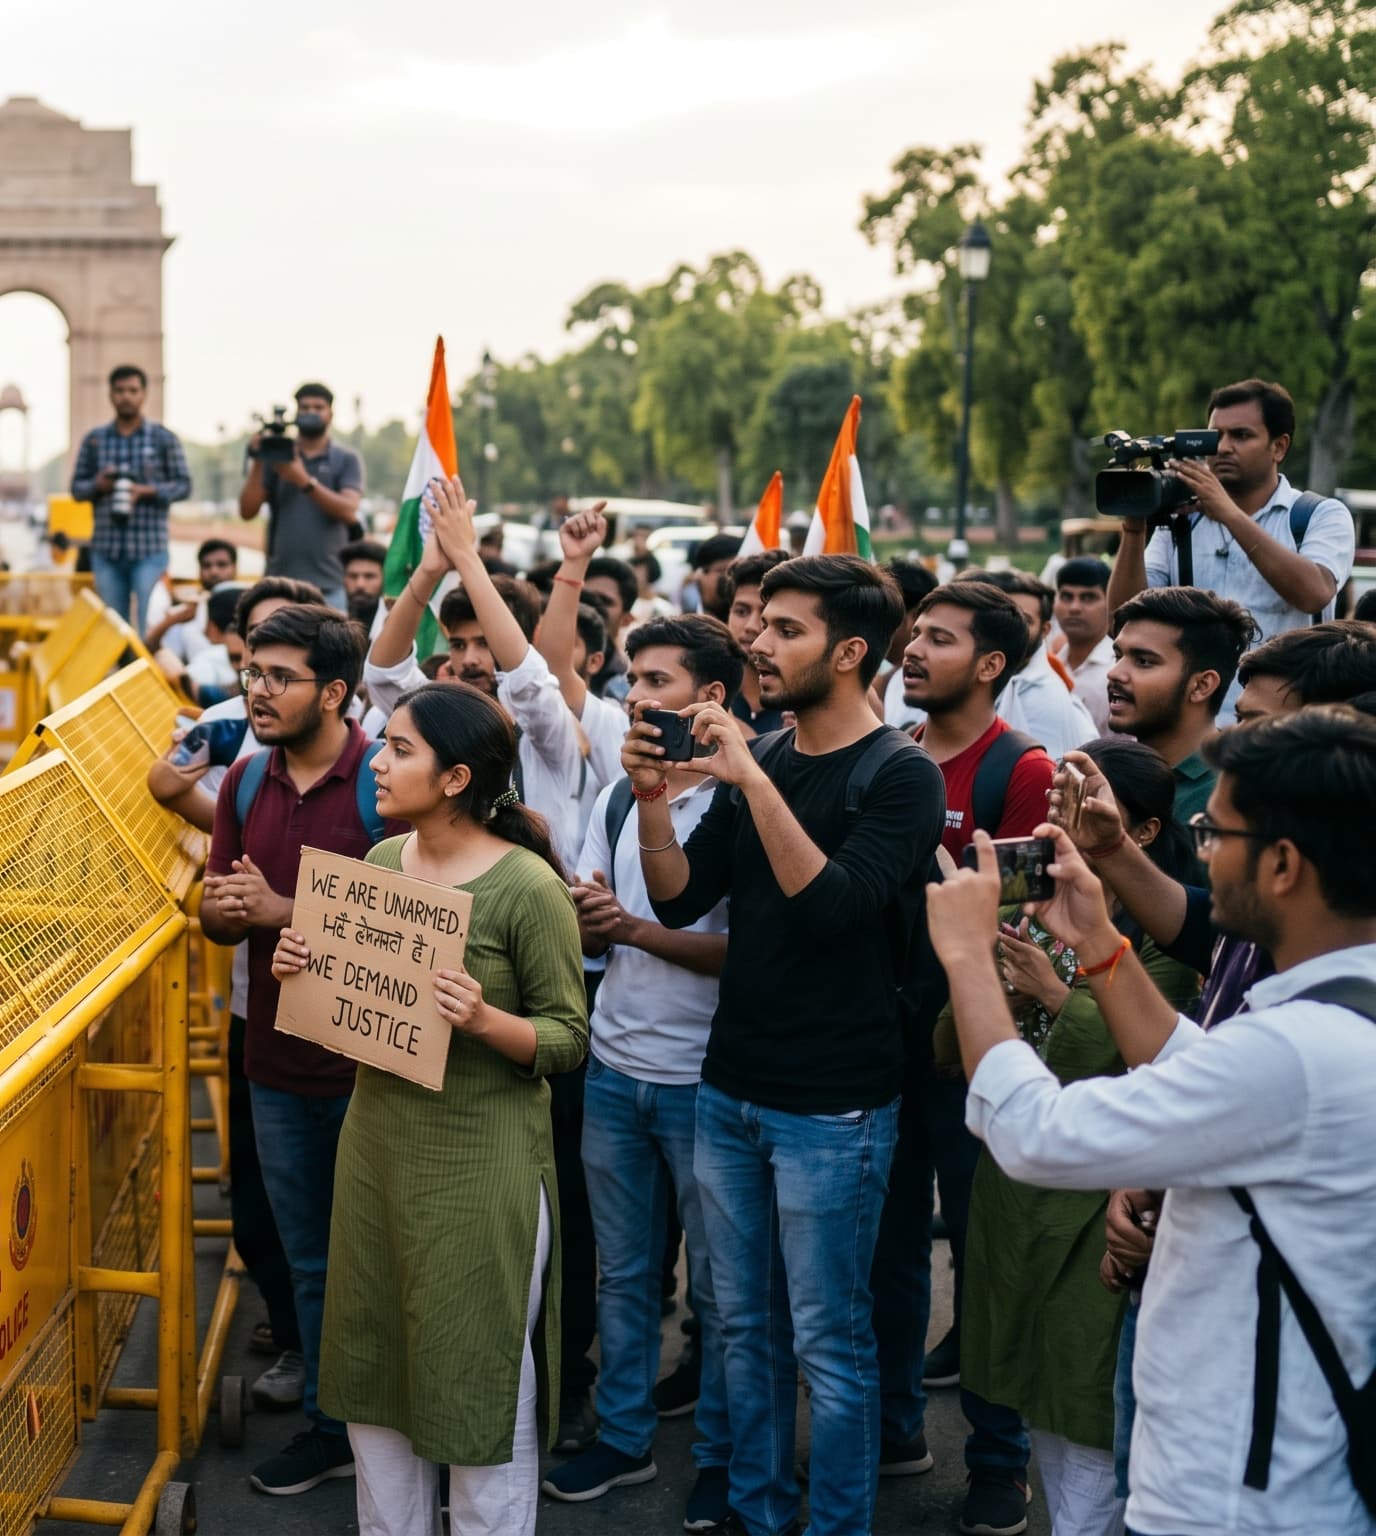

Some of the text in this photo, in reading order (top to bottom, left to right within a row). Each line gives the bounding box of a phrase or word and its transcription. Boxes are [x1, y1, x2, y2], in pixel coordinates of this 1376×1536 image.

[311, 868, 464, 938] WE ARE UNARMED.
[308, 953, 418, 1008] WE DEMAND
